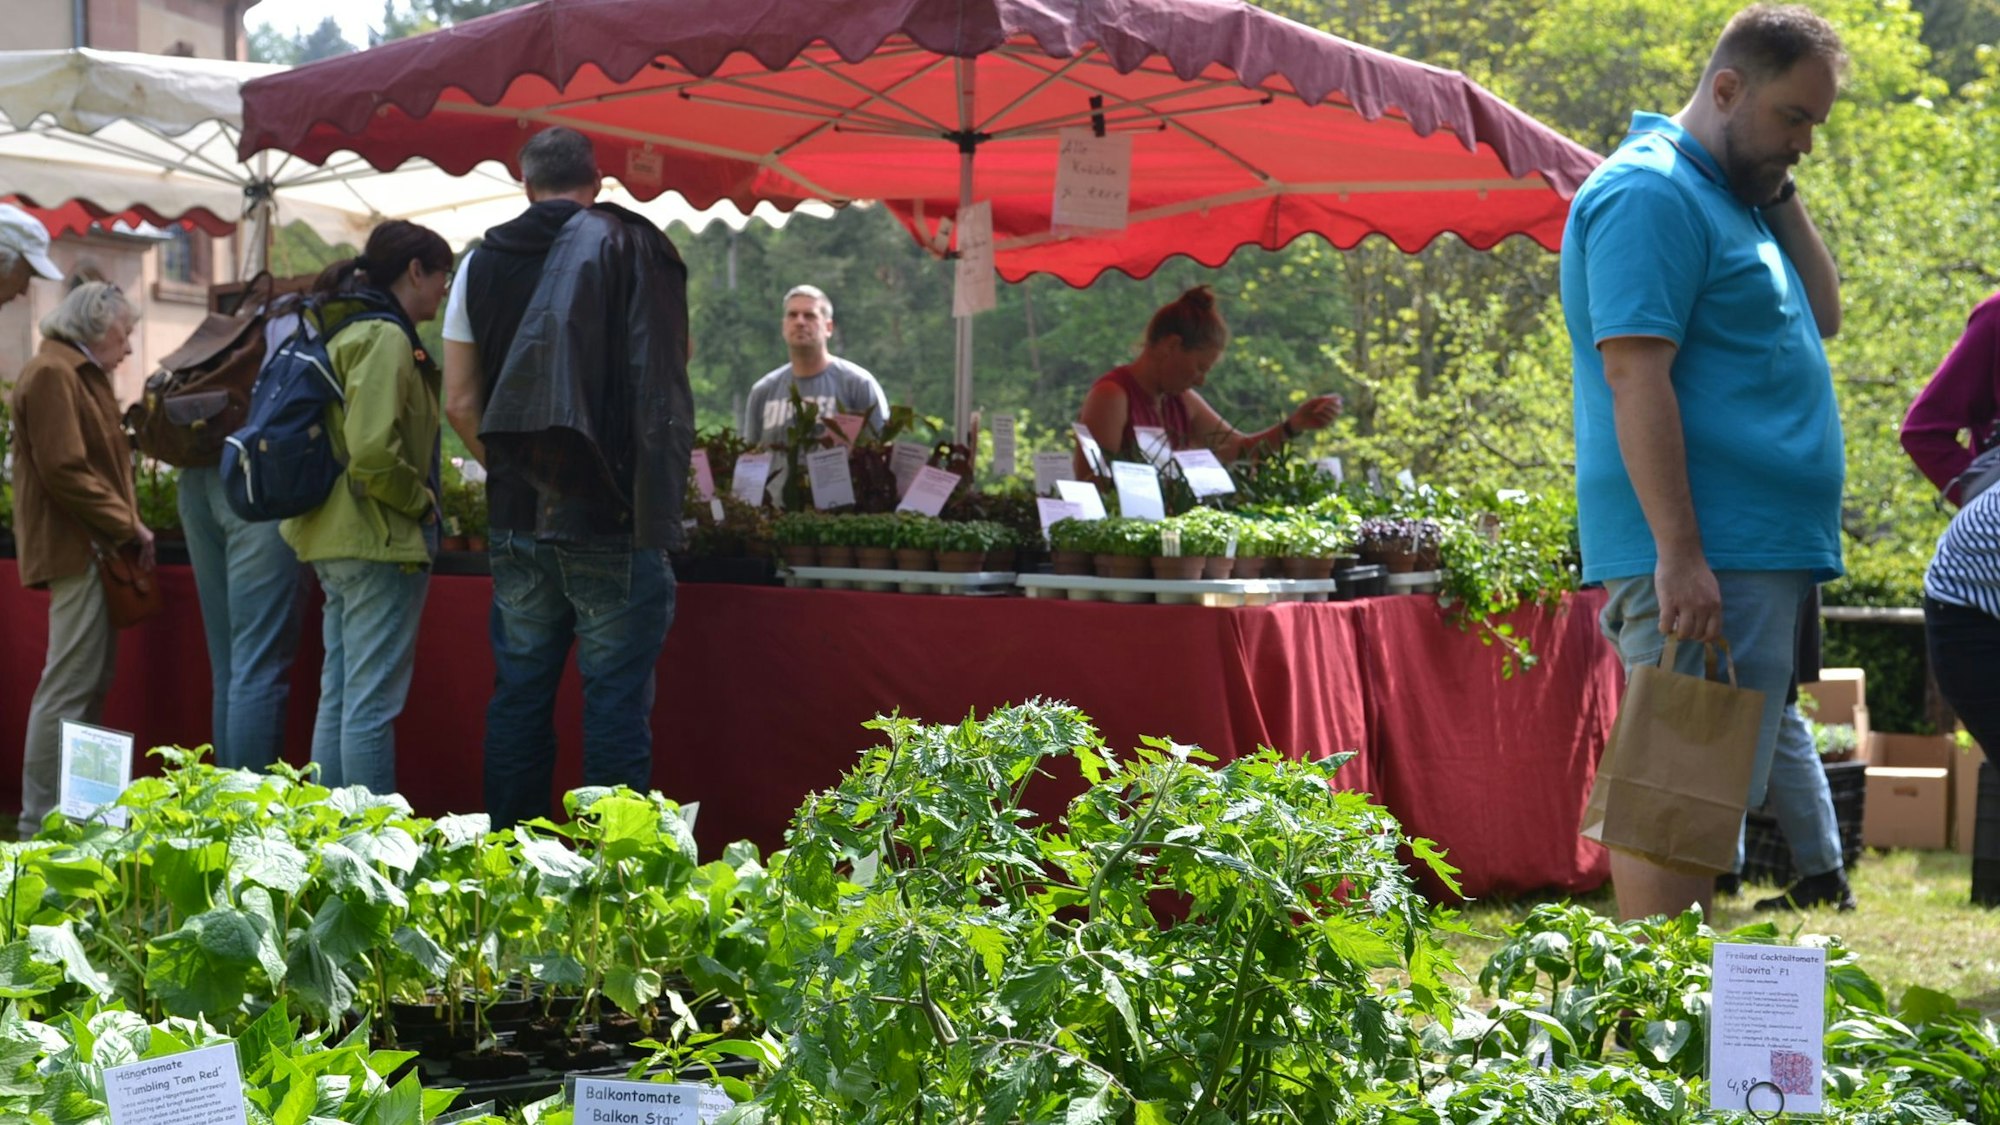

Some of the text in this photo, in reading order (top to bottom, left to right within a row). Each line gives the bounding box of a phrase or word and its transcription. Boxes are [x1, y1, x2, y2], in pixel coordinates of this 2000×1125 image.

[1725, 951, 1820, 963] Freiland Cocktailtomate
[1779, 968, 1790, 976] F1
[115, 1060, 183, 1082] Hängetomate
[173, 1073, 196, 1086] Tom
[586, 1086, 681, 1105] Balkontomate
